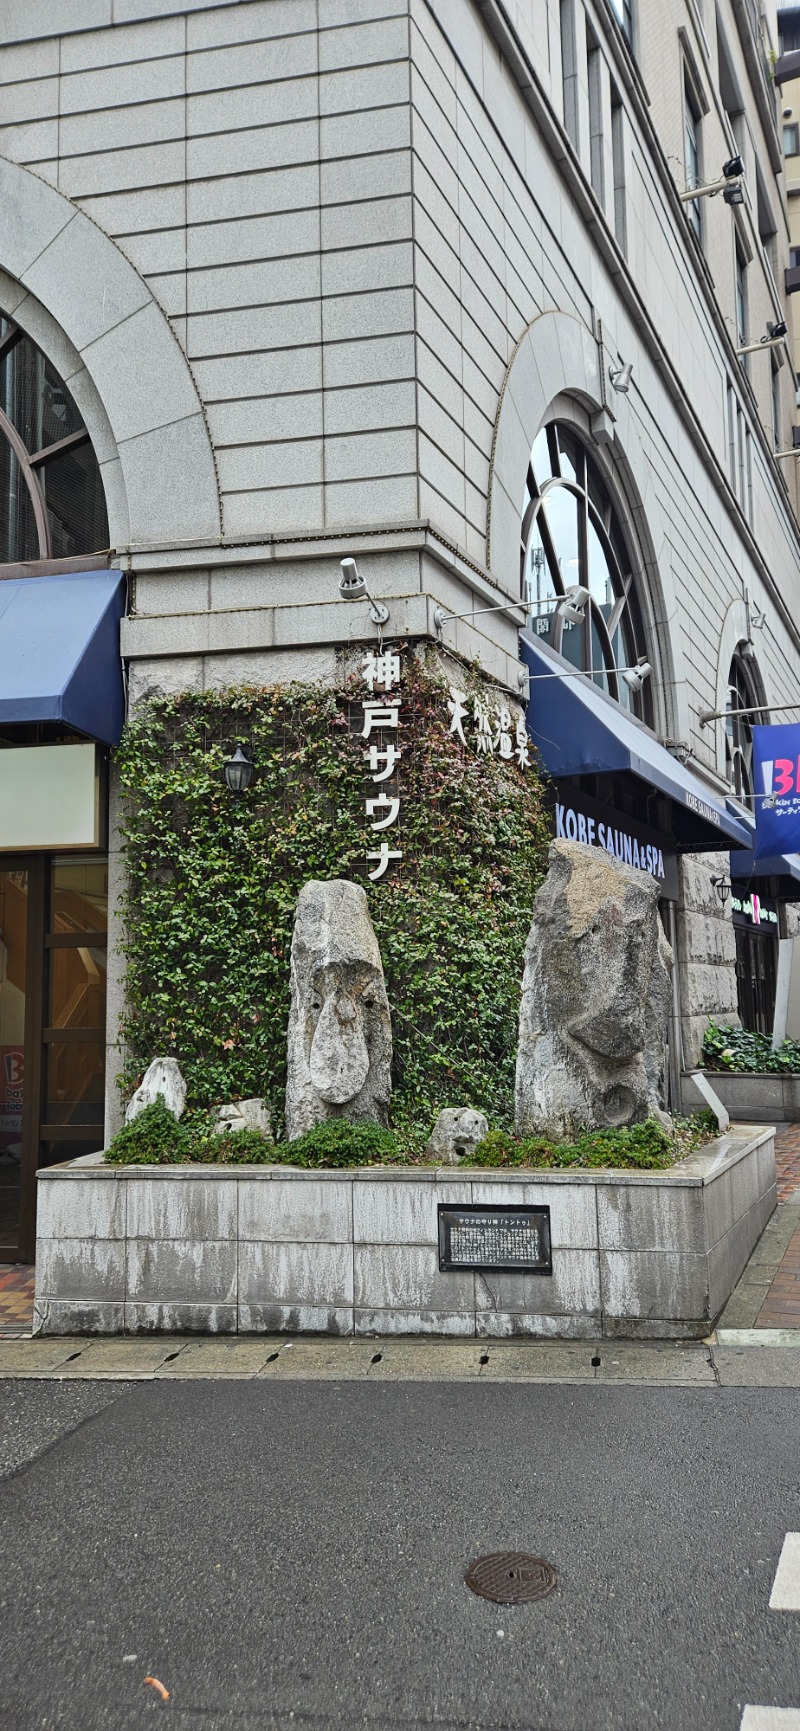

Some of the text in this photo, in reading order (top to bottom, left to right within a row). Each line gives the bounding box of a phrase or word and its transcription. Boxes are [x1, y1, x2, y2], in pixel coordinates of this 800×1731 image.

[362, 651, 402, 881] 神戸サウナ
[447, 686, 532, 770] 天然温泉
[555, 803, 665, 879] KOBE SAUNA&SPA
[686, 792, 698, 812] KOBE
